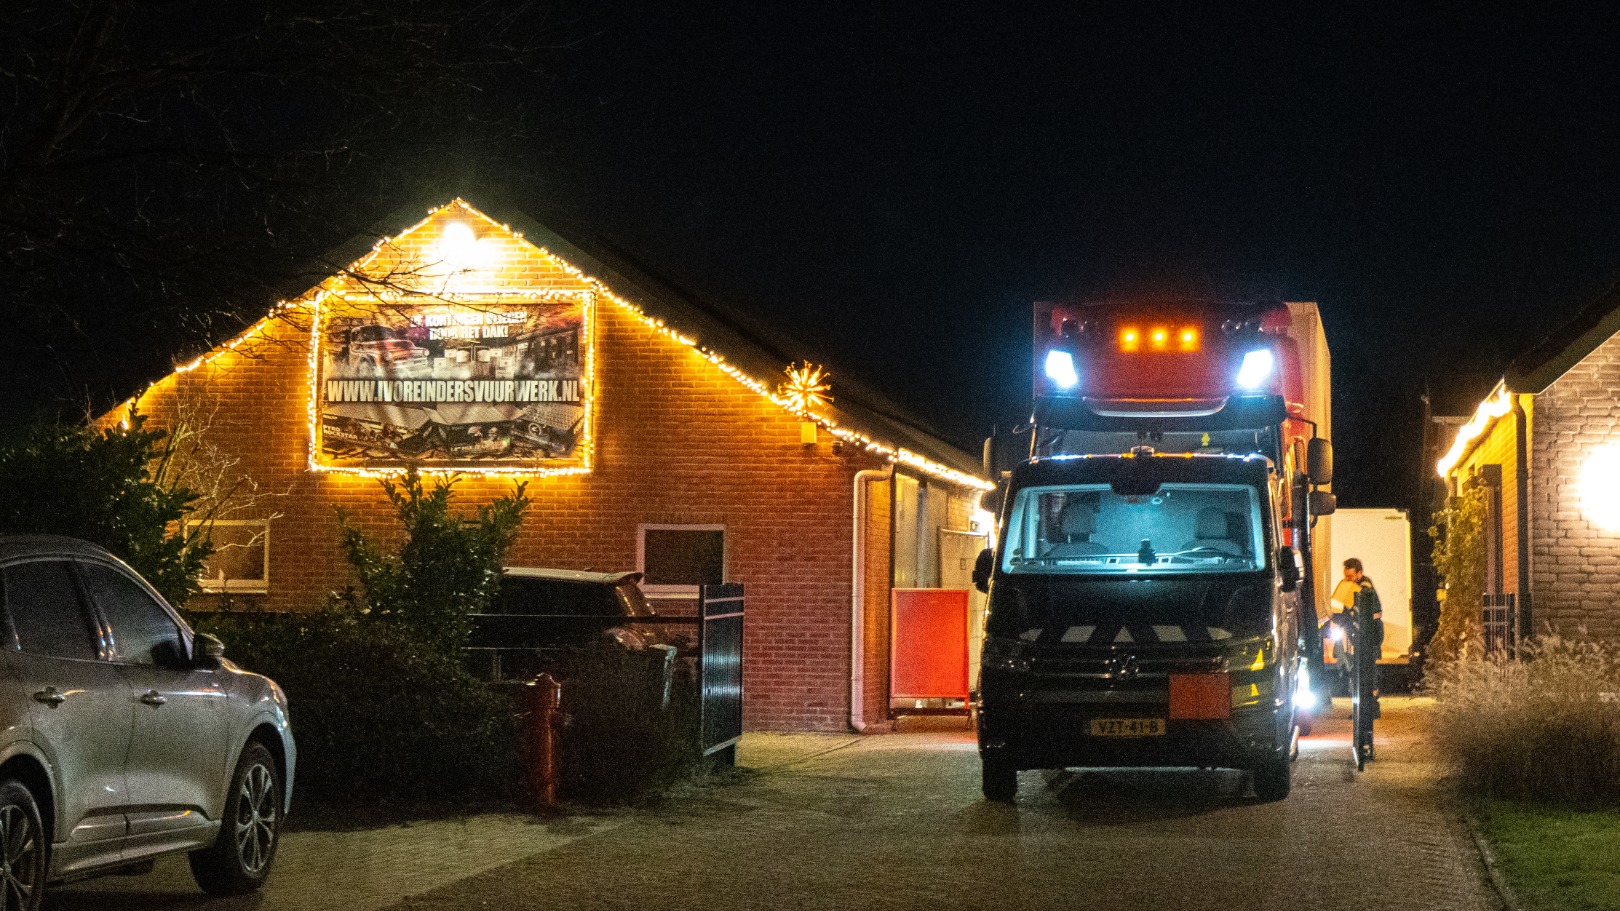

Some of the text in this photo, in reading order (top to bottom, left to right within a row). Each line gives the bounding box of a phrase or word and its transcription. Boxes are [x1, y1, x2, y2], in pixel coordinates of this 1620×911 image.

[429, 325, 509, 340] DOOR HET DAK!
[327, 380, 580, 402] WWW.IVOREINDERSVUURWERK.NL
[323, 429, 358, 440] ROCKSTAR
